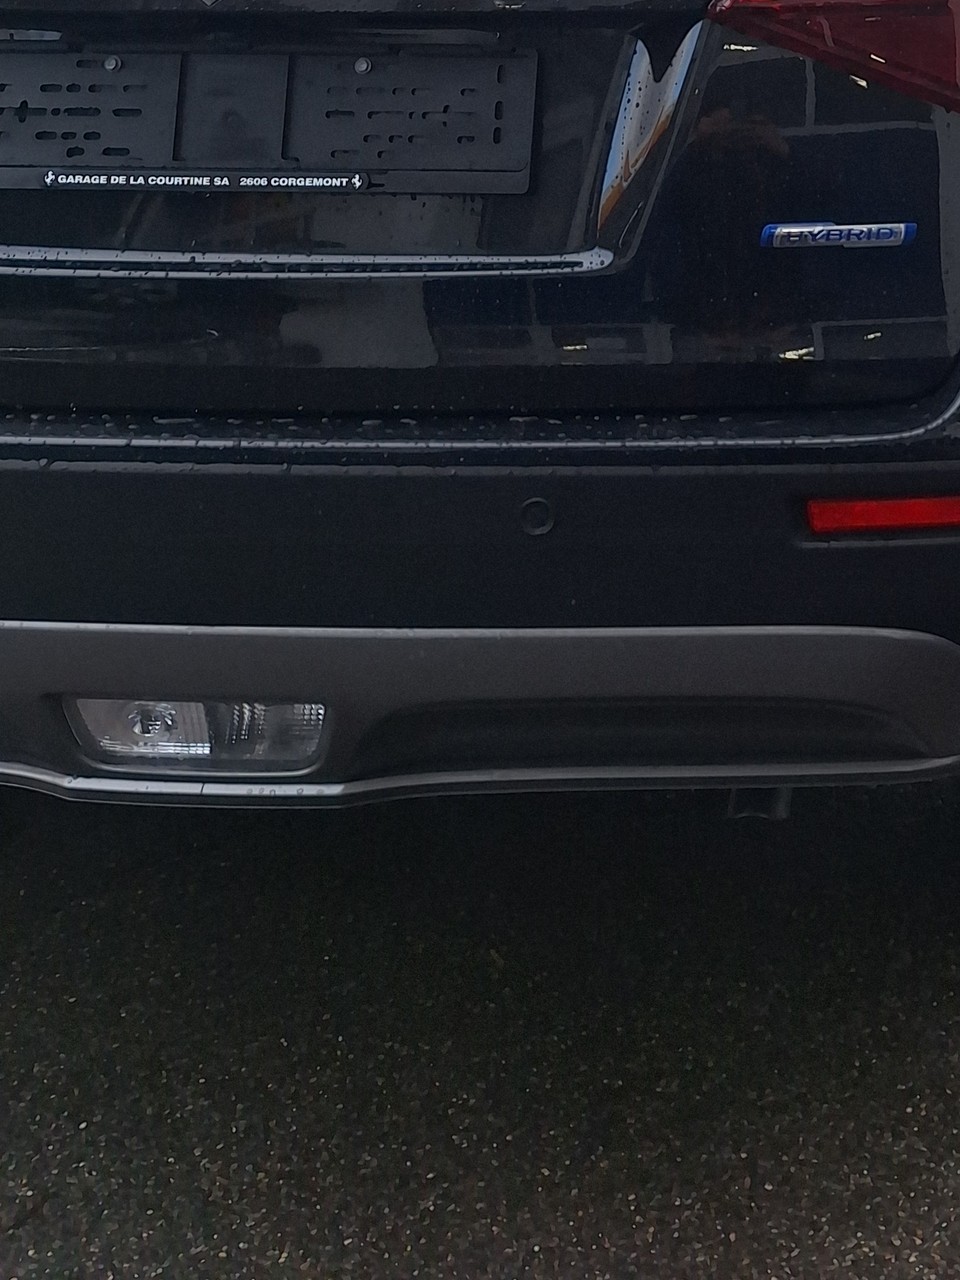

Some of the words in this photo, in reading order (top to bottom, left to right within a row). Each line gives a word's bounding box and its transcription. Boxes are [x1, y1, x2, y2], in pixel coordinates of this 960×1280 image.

[57, 174, 108, 184] GARAGE
[110, 175, 126, 185] DE
[129, 176, 145, 185] LA
[148, 176, 211, 186] COURTINE
[213, 176, 230, 186] SA
[239, 176, 268, 186] 2606
[270, 176, 349, 187] CORGEMONT
[787, 227, 894, 242] HYBRID
